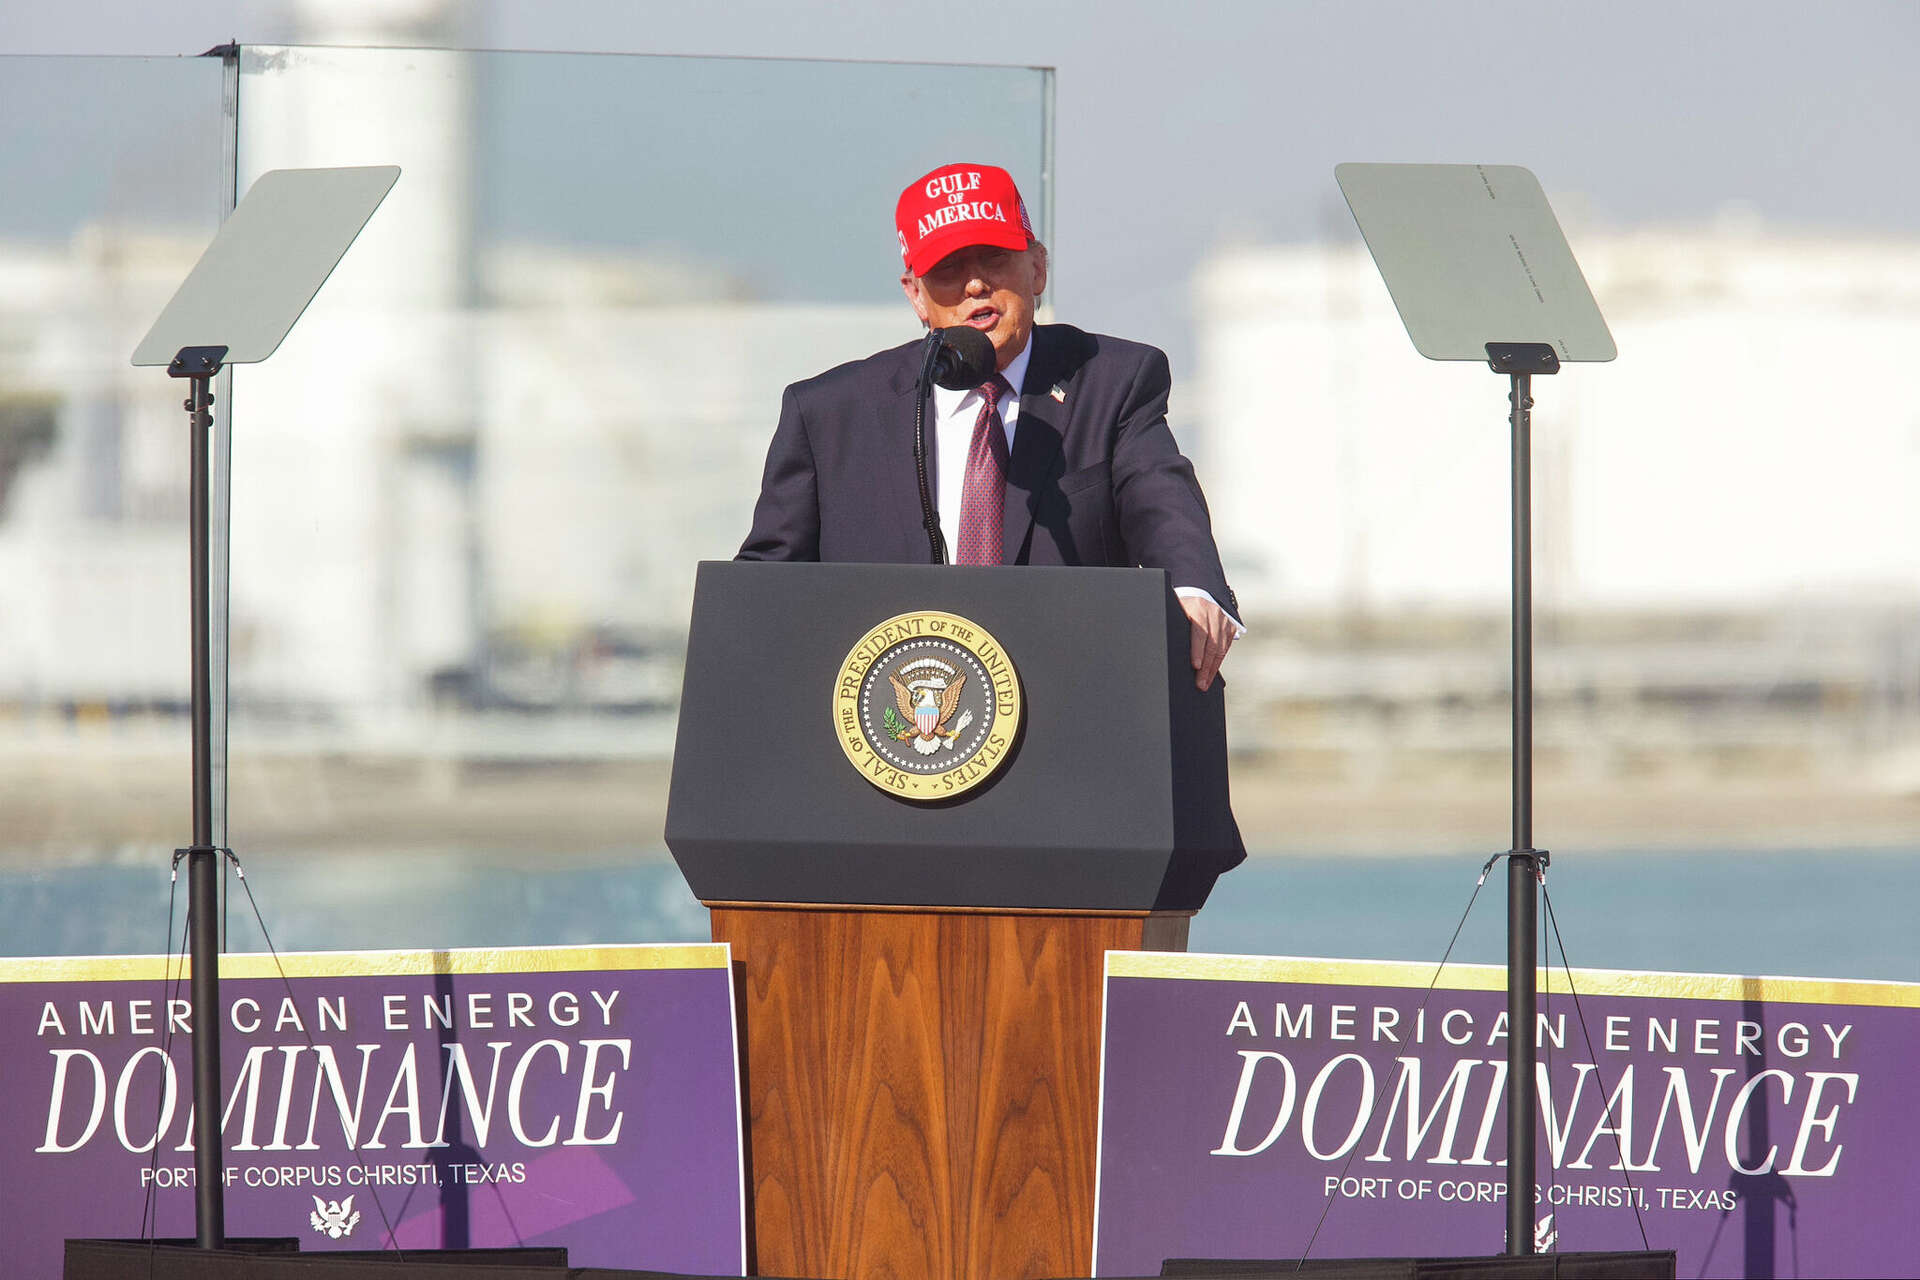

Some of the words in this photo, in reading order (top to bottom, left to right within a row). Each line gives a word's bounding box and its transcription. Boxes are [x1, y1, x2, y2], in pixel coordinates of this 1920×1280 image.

[926, 172, 981, 198] GULF
[948, 192, 964, 204] OF
[917, 201, 1007, 240] AMERICA
[930, 620, 947, 632] OF
[951, 625, 974, 642] THE
[841, 618, 923, 700] PRESIDENT
[977, 641, 1014, 717] UNITED
[842, 707, 856, 733] THE
[848, 734, 863, 752] OF
[862, 753, 909, 790] SEAL
[942, 733, 1005, 790] STATES
[37, 997, 348, 1035] AMERCAN
[383, 990, 620, 1031] ENERGY
[1226, 1001, 1566, 1049] AMERICAN
[1605, 1015, 1852, 1059] ENERGY
[1209, 1050, 1860, 1177] DOMINANCE
[244, 1166, 341, 1187] CORPUS
[346, 1164, 443, 1187] CHRISTI,
[449, 1163, 526, 1184] TEXAS
[1325, 1176, 1392, 1198] PORT
[1397, 1179, 1432, 1200] OF
[1438, 1180, 1542, 1204] CORPS
[1547, 1184, 1649, 1211] CHRISTI,
[1656, 1188, 1737, 1210] TEXAS
